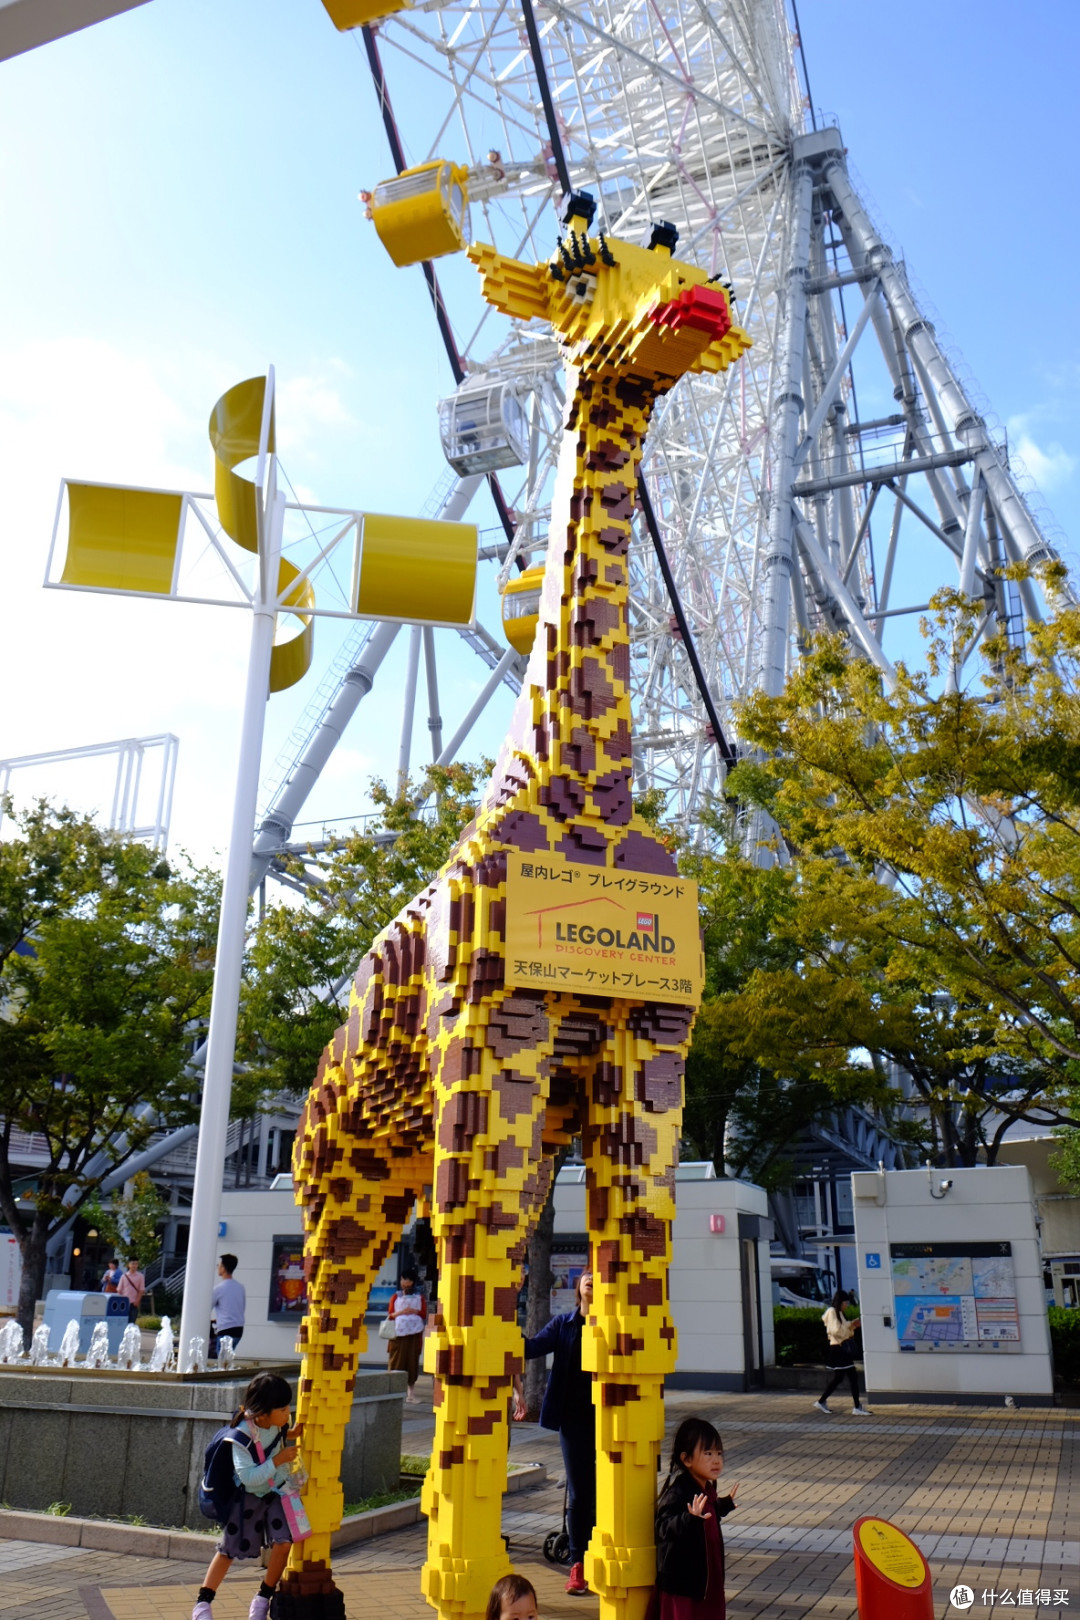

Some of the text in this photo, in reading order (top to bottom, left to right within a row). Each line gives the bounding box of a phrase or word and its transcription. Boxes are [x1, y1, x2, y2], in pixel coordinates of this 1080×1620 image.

[588, 873, 684, 898] プレイグラウンド
[556, 914, 675, 953] LEGOLAND
[637, 916, 652, 927] LEGO
[555, 944, 676, 966] DISCOVERY CENTER
[514, 960, 692, 994] 天保山マーケットプレース3階
